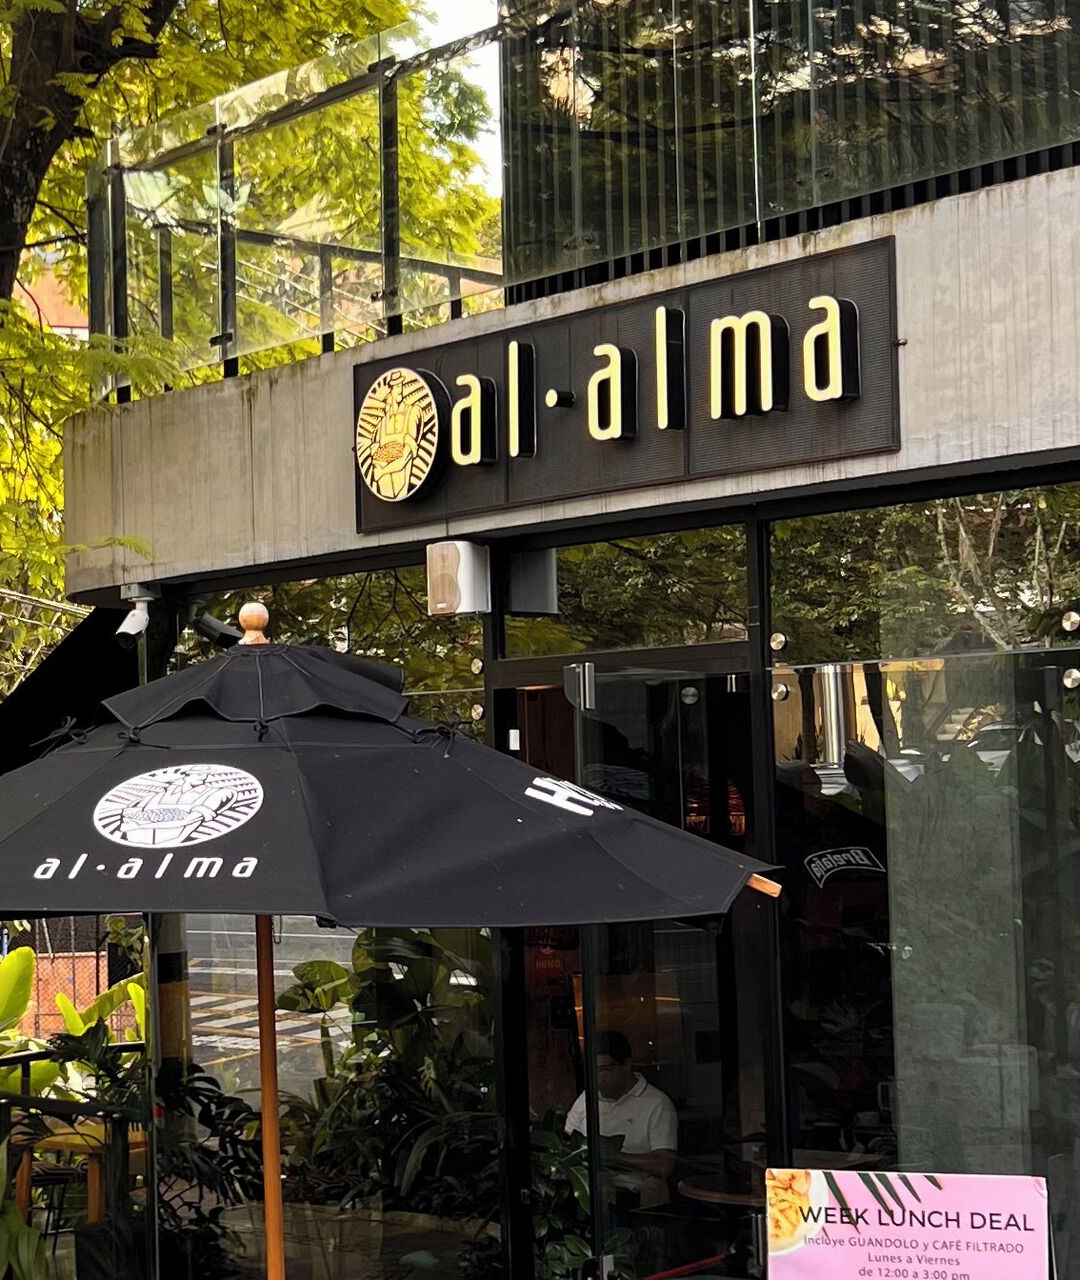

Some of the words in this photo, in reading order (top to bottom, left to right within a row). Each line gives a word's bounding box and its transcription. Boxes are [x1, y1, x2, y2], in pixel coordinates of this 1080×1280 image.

[798, 1205, 870, 1226] WEEK
[878, 1208, 961, 1229] LUNCH
[969, 1211, 1035, 1232] DEAL
[804, 1234, 845, 1248] Incluye
[848, 1236, 919, 1250] GUANDOLO
[923, 1241, 929, 1251] y
[932, 1239, 962, 1252] CAFÉ
[965, 1241, 1025, 1254] FILTRADO
[867, 1252, 903, 1264] Lunes
[906, 1255, 913, 1264] a
[916, 1254, 961, 1266] Viernes
[858, 1266, 874, 1277] de
[877, 1267, 909, 1279] 12:00
[912, 1271, 919, 1279] a
[923, 1269, 948, 1280] 3:00
